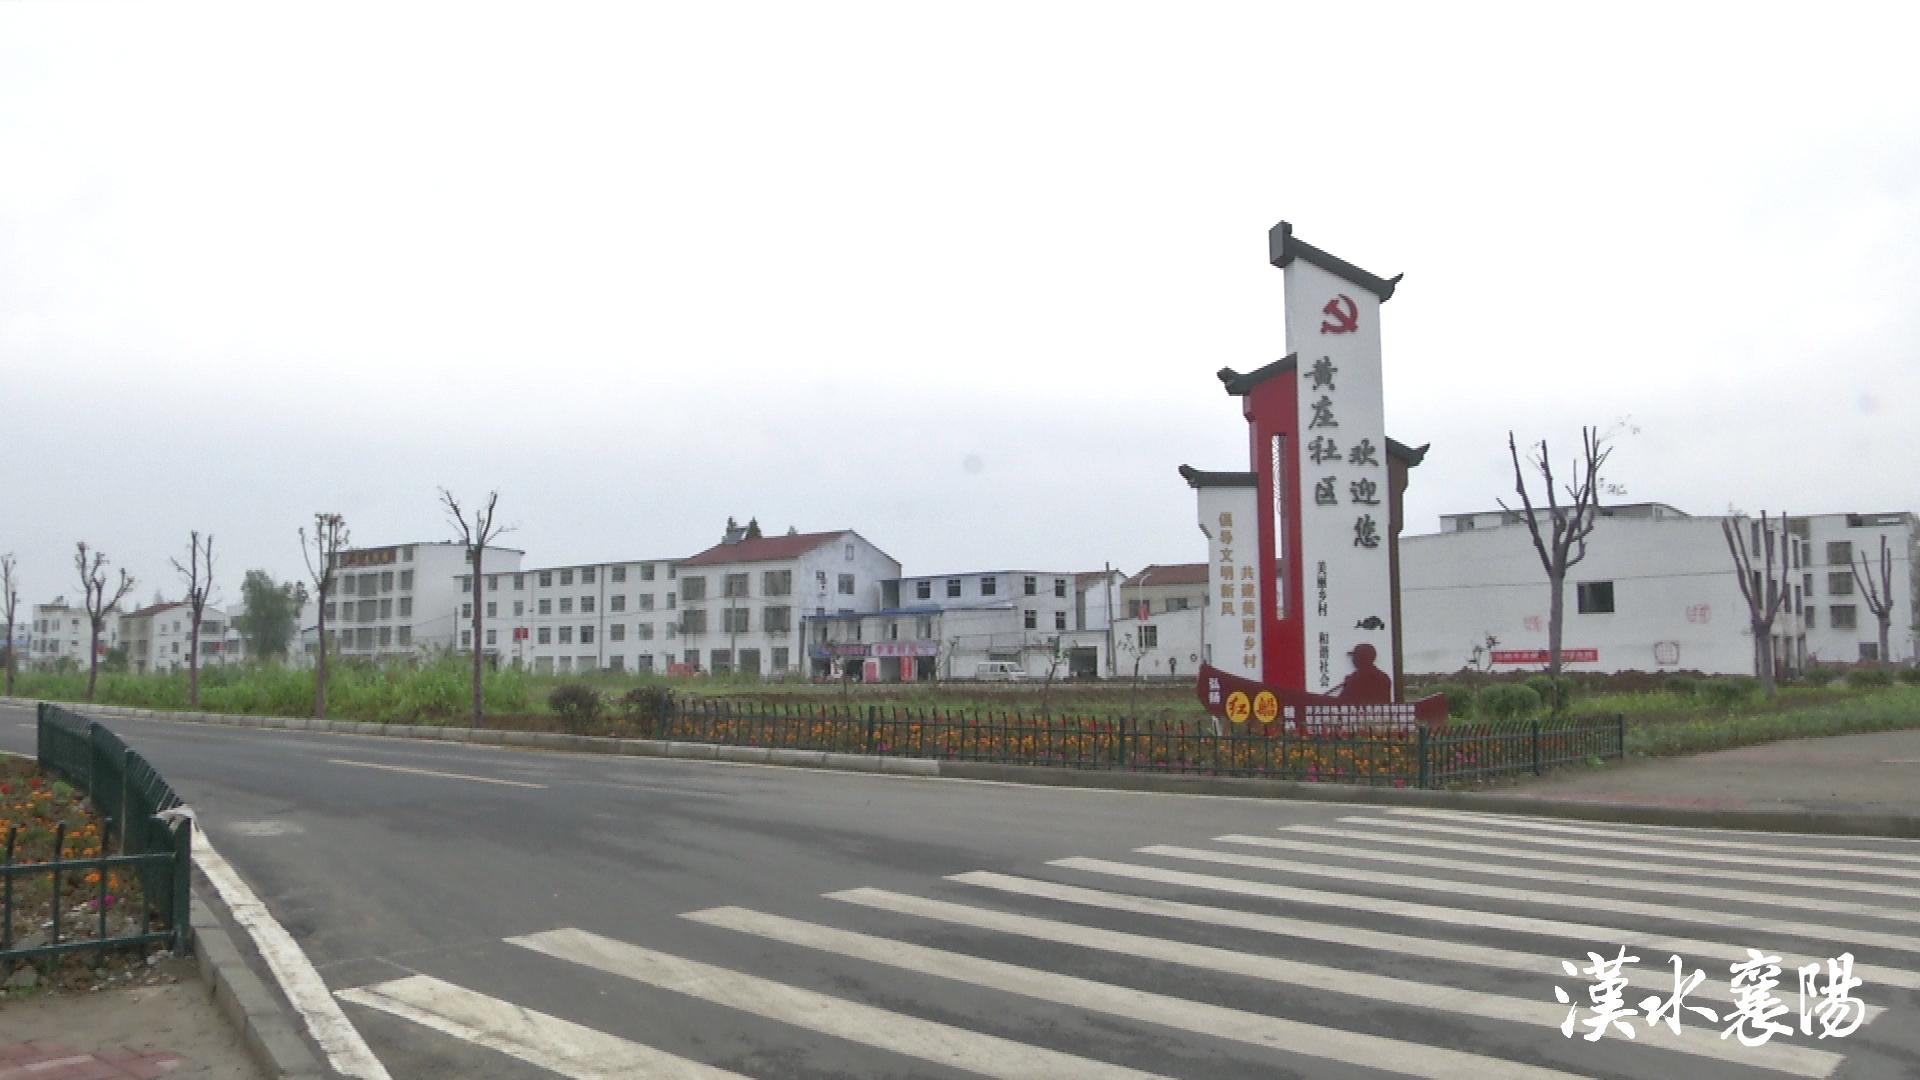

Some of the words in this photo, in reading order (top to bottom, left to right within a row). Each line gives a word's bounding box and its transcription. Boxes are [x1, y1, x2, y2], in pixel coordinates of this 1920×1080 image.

[1303, 355, 1342, 506] 黄庄社区
[1349, 437, 1381, 548] 欢迎您
